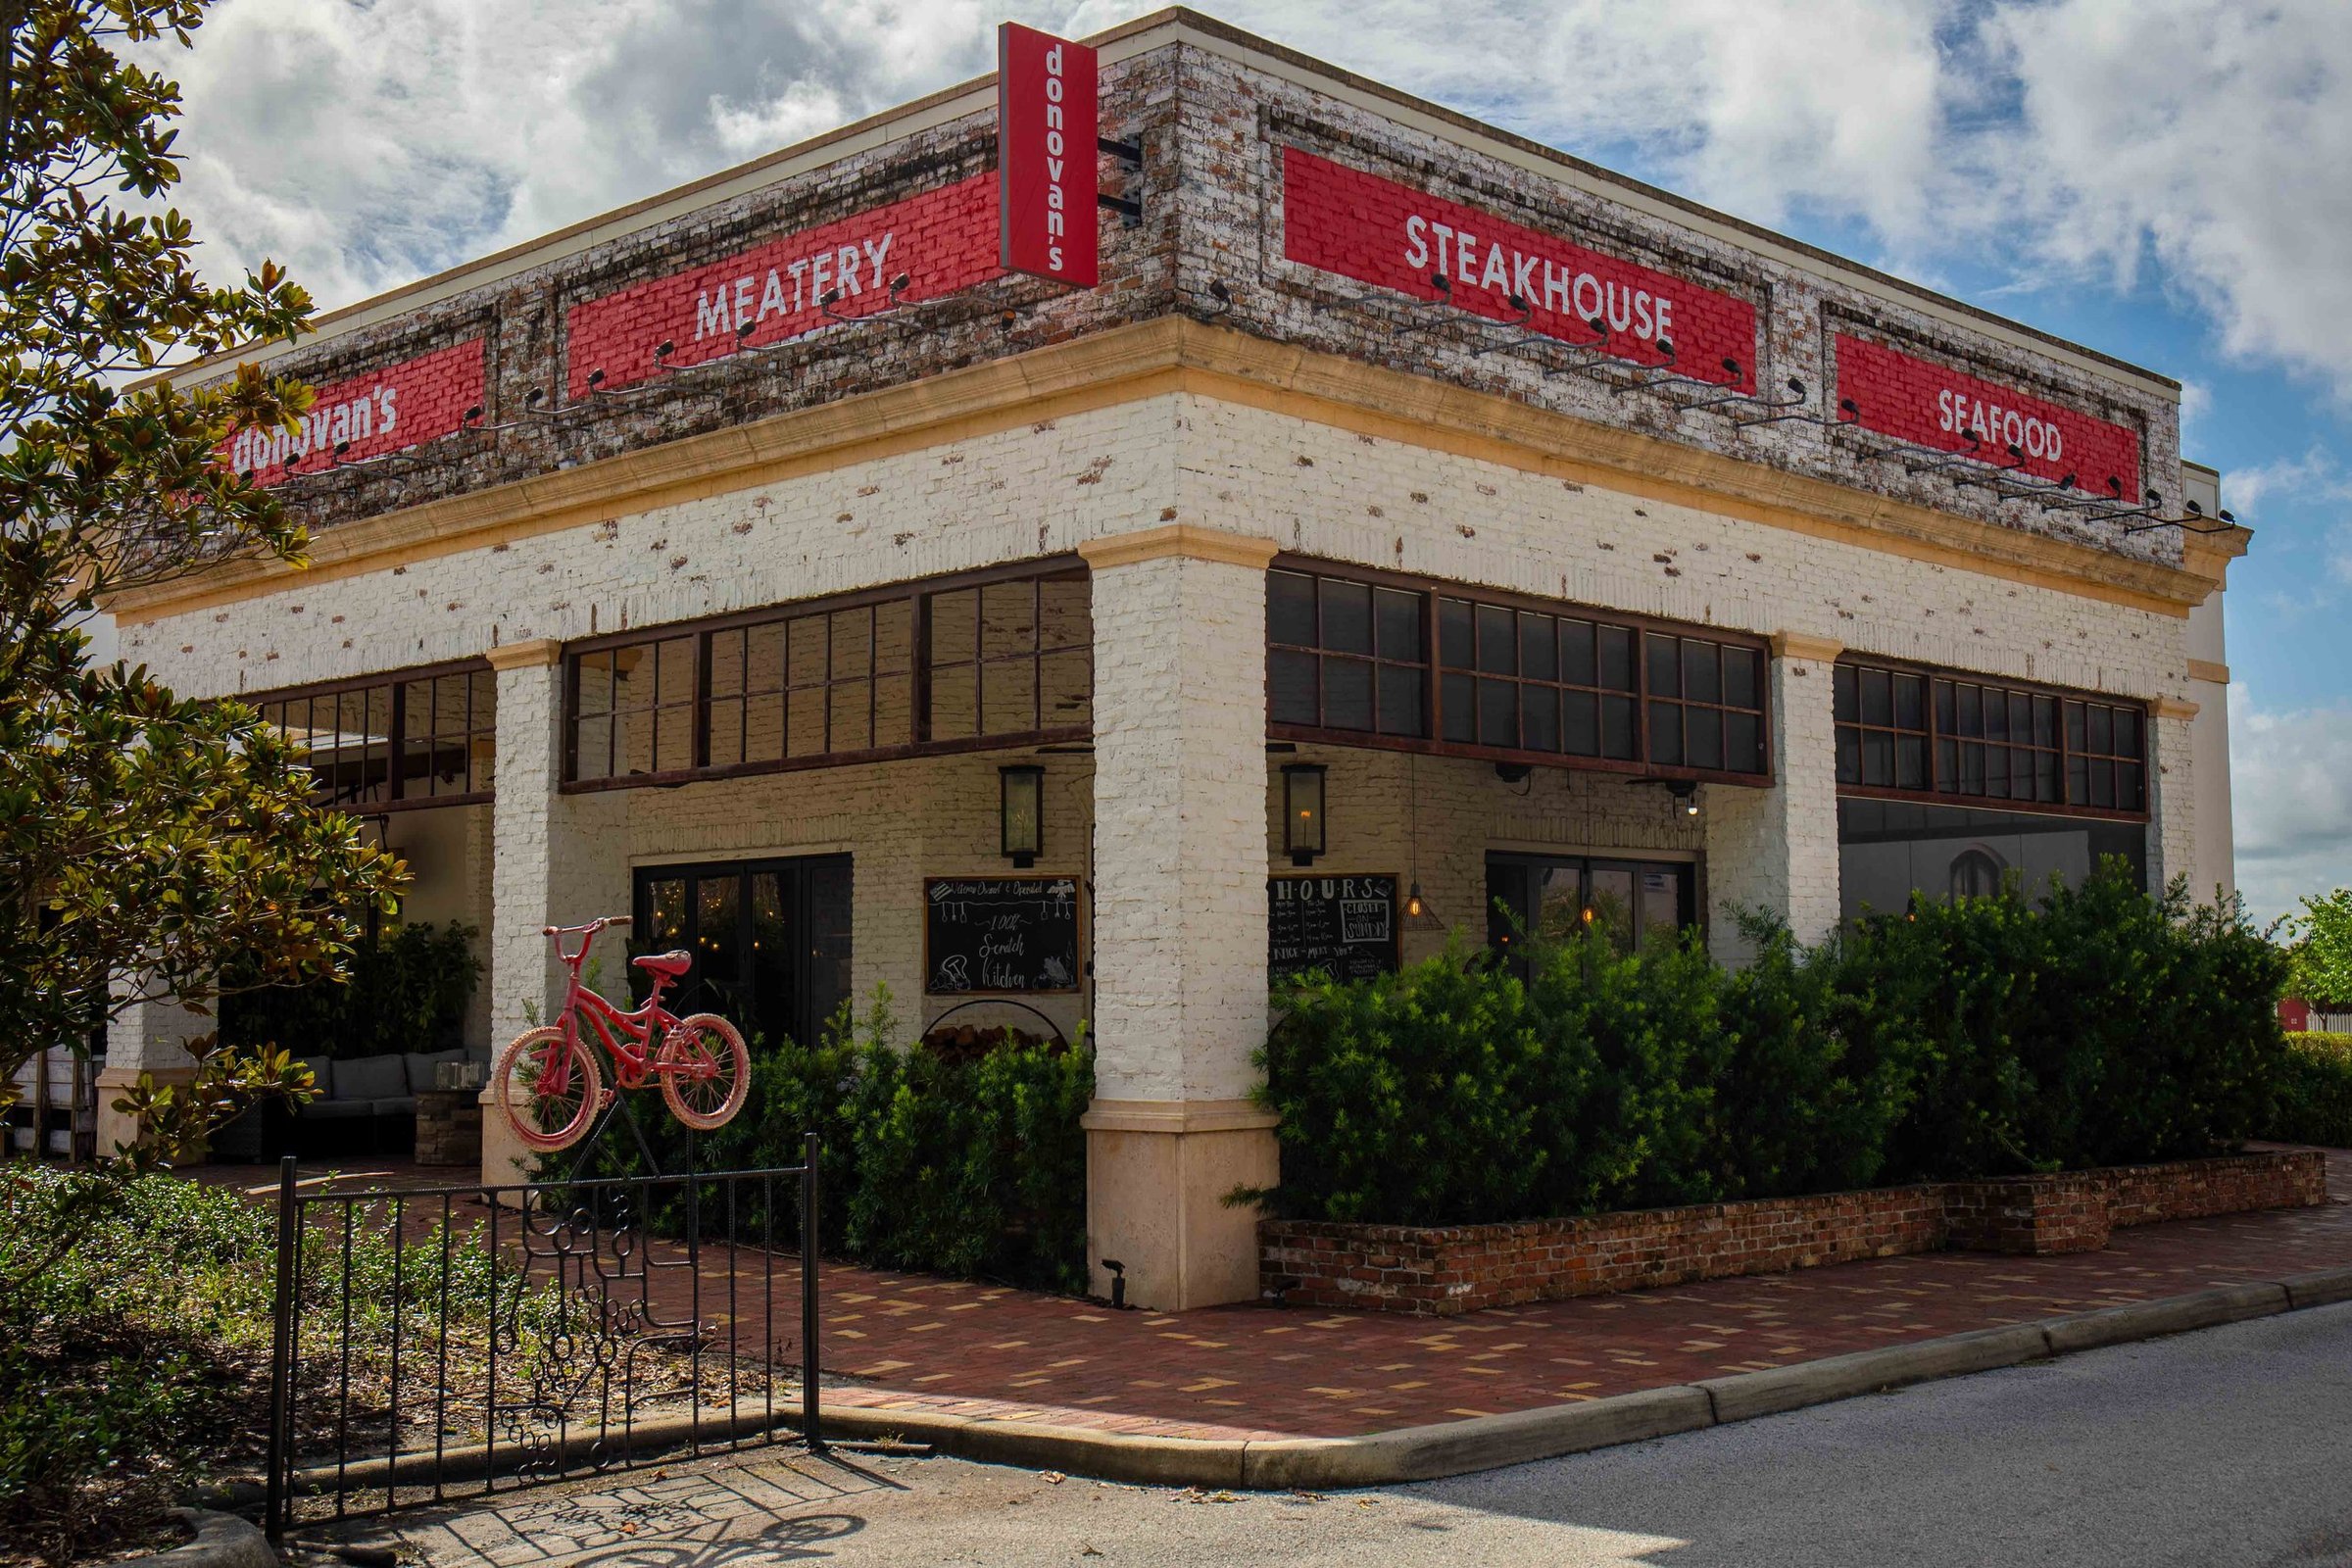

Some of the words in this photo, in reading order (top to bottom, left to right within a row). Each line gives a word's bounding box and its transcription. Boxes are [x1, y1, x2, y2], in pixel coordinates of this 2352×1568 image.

[1045, 44, 1064, 271] donovan's
[694, 232, 893, 341] MEATERY
[1404, 215, 1673, 345] STEAKHOUSE
[1938, 389, 2062, 462] SEAFOOD
[979, 933, 1025, 957] Scratch
[982, 956, 1025, 989] Kitchen
